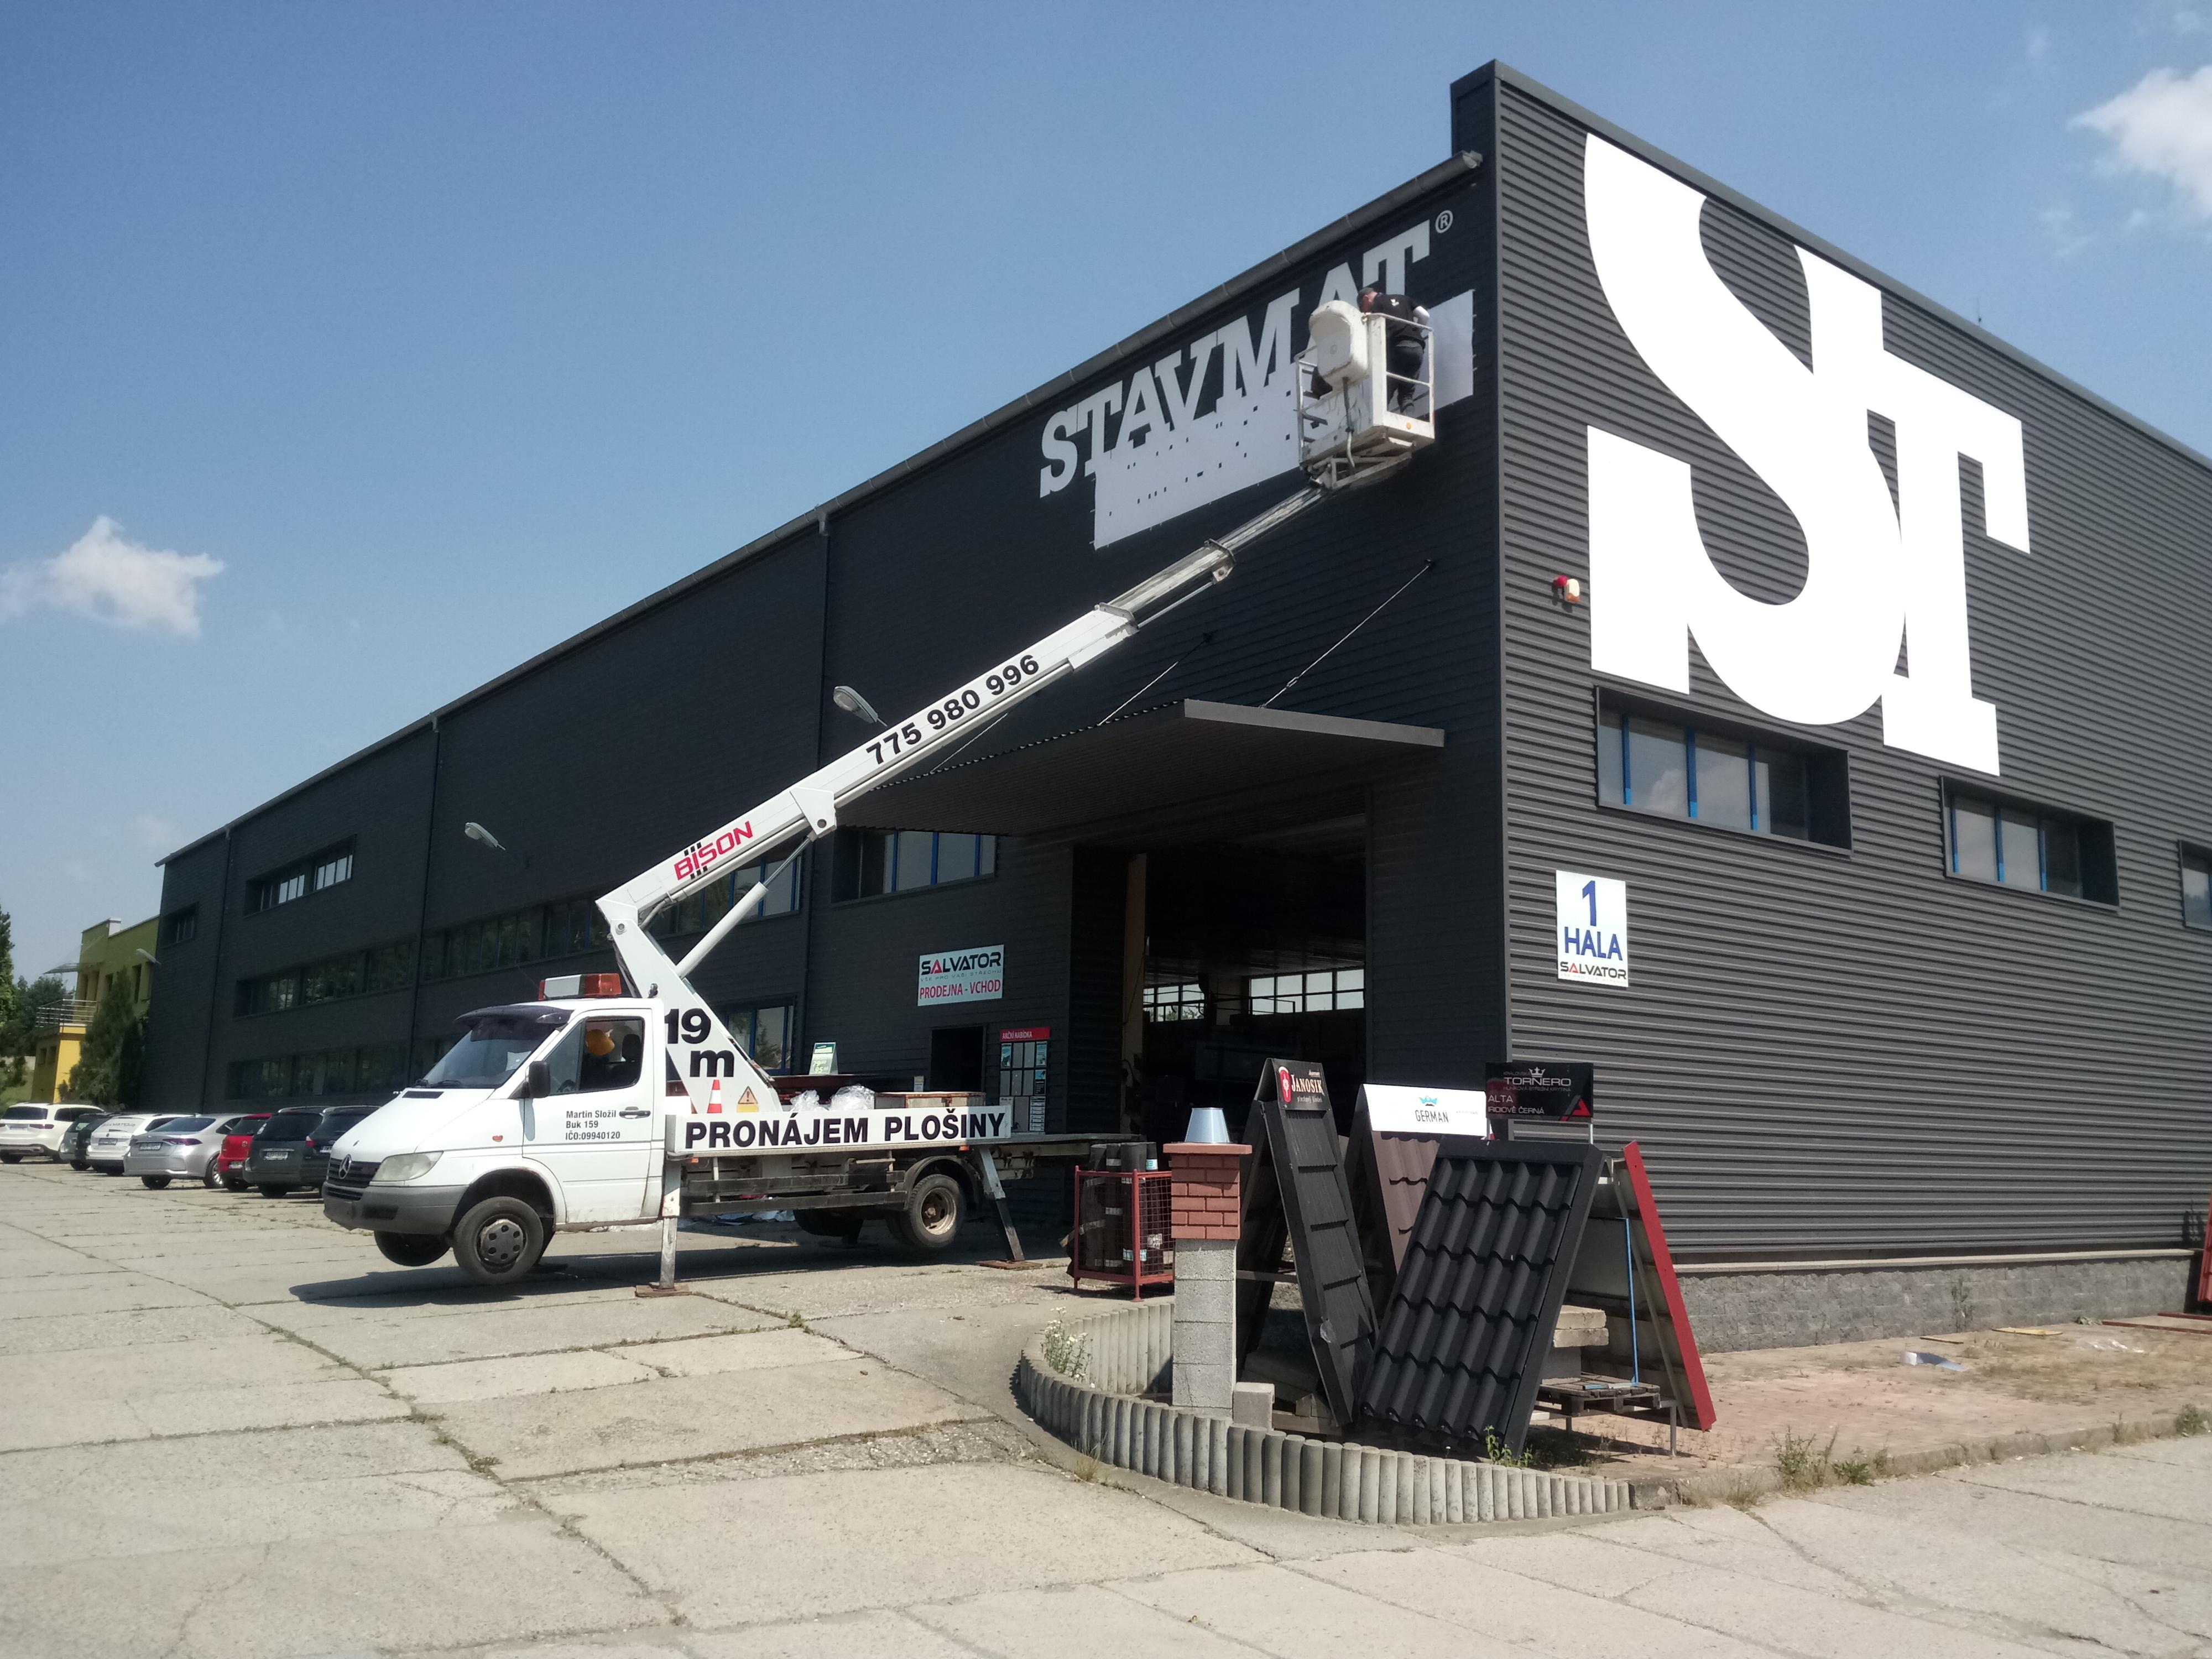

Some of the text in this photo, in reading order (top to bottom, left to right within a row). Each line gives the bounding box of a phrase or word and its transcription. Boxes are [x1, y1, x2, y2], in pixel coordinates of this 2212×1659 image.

[865, 654, 1039, 765] 775 980 996
[674, 821, 753, 880] BISON
[1582, 880, 1597, 927] 1
[1564, 926, 1623, 961] HALA
[921, 951, 1001, 975] SALVATOR
[1559, 961, 1627, 980] SALVATOR
[920, 983, 963, 999] PRODEJNA
[969, 979, 1001, 994] VCHOD
[664, 1008, 712, 1044] 19
[689, 1050, 735, 1078] m
[1504, 1077, 1572, 1087] TORNERO
[1488, 1094, 1514, 1103] ALTA
[594, 1110, 617, 1118] Složil
[1415, 1109, 1449, 1123] GERMAN
[1518, 1105, 1545, 1114] ČERNÁ
[566, 1120, 599, 1129] Buk 159
[685, 1113, 869, 1149] PRONÁJEM
[884, 1108, 1005, 1142] PLOŠINY
[565, 1130, 620, 1140] IČO:09940120
